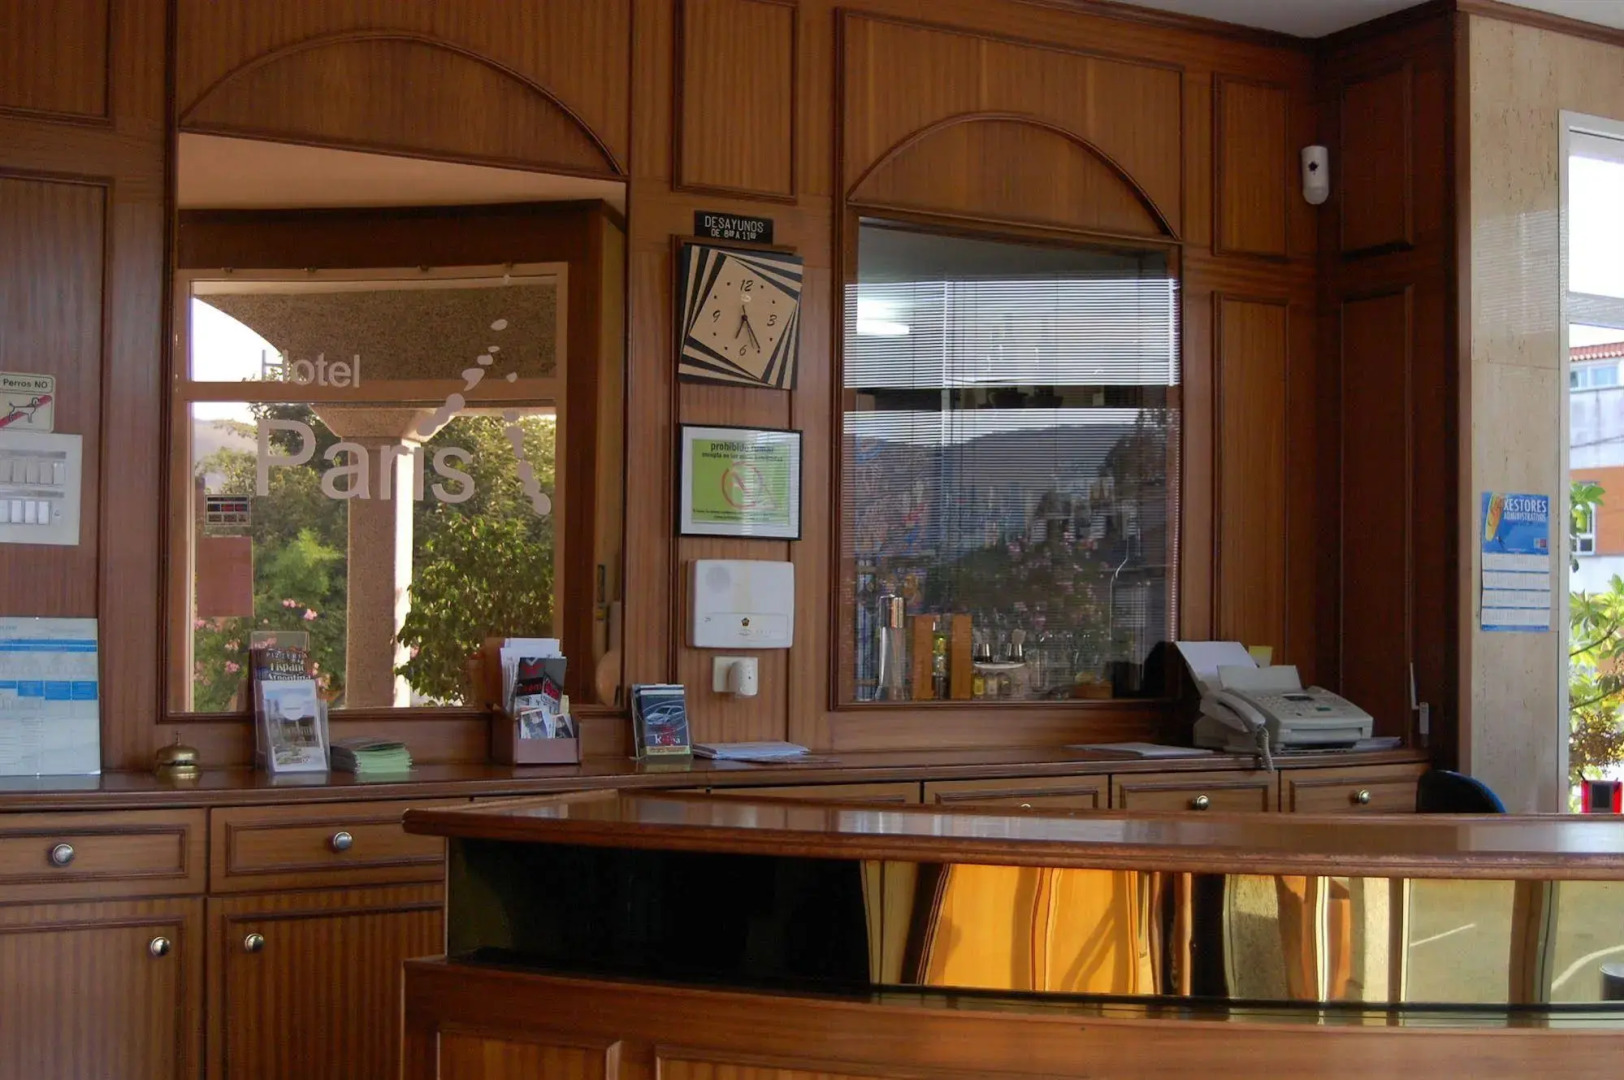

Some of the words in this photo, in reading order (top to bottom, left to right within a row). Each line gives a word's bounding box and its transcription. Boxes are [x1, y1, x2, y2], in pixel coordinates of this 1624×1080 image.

[704, 215, 764, 233] DESAYUNOS
[710, 228, 721, 238] DE
[740, 279, 754, 292] 12
[712, 310, 721, 323] 9
[766, 314, 778, 328] 3
[739, 344, 747, 356] 6
[261, 348, 361, 389] Hotel
[3, 378, 32, 388] Perros
[34, 380, 48, 389] NO
[255, 418, 476, 504] Paris
[1504, 498, 1547, 513] XESTORES
